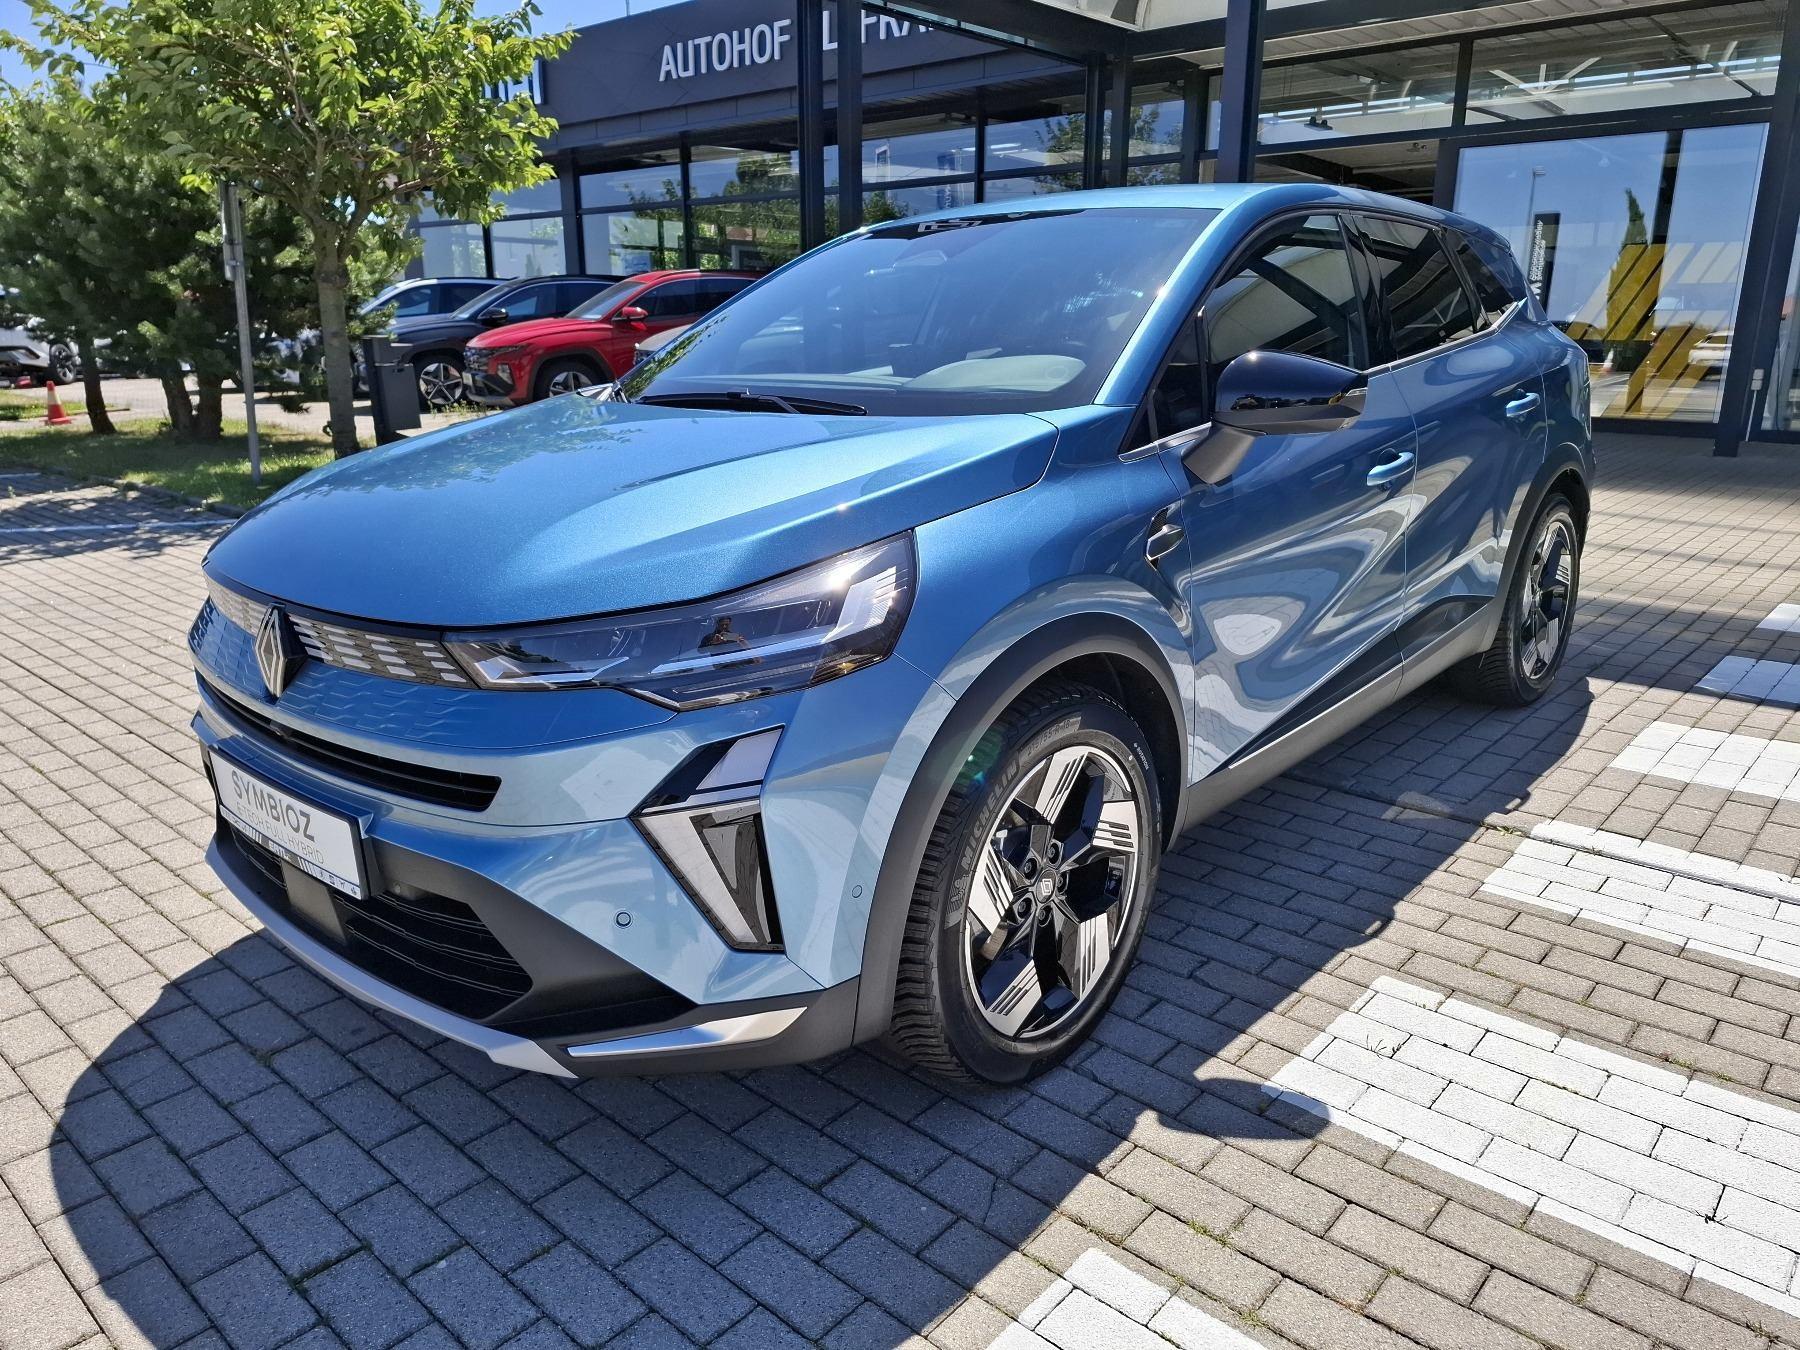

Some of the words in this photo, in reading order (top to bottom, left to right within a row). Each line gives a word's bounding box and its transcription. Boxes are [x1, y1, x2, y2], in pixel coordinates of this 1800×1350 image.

[659, 18, 792, 82] AUTOHOF
[231, 769, 316, 843] SYMBIOZ
[961, 760, 1018, 870] MICHELIN
[287, 833, 325, 866] HYBRID
